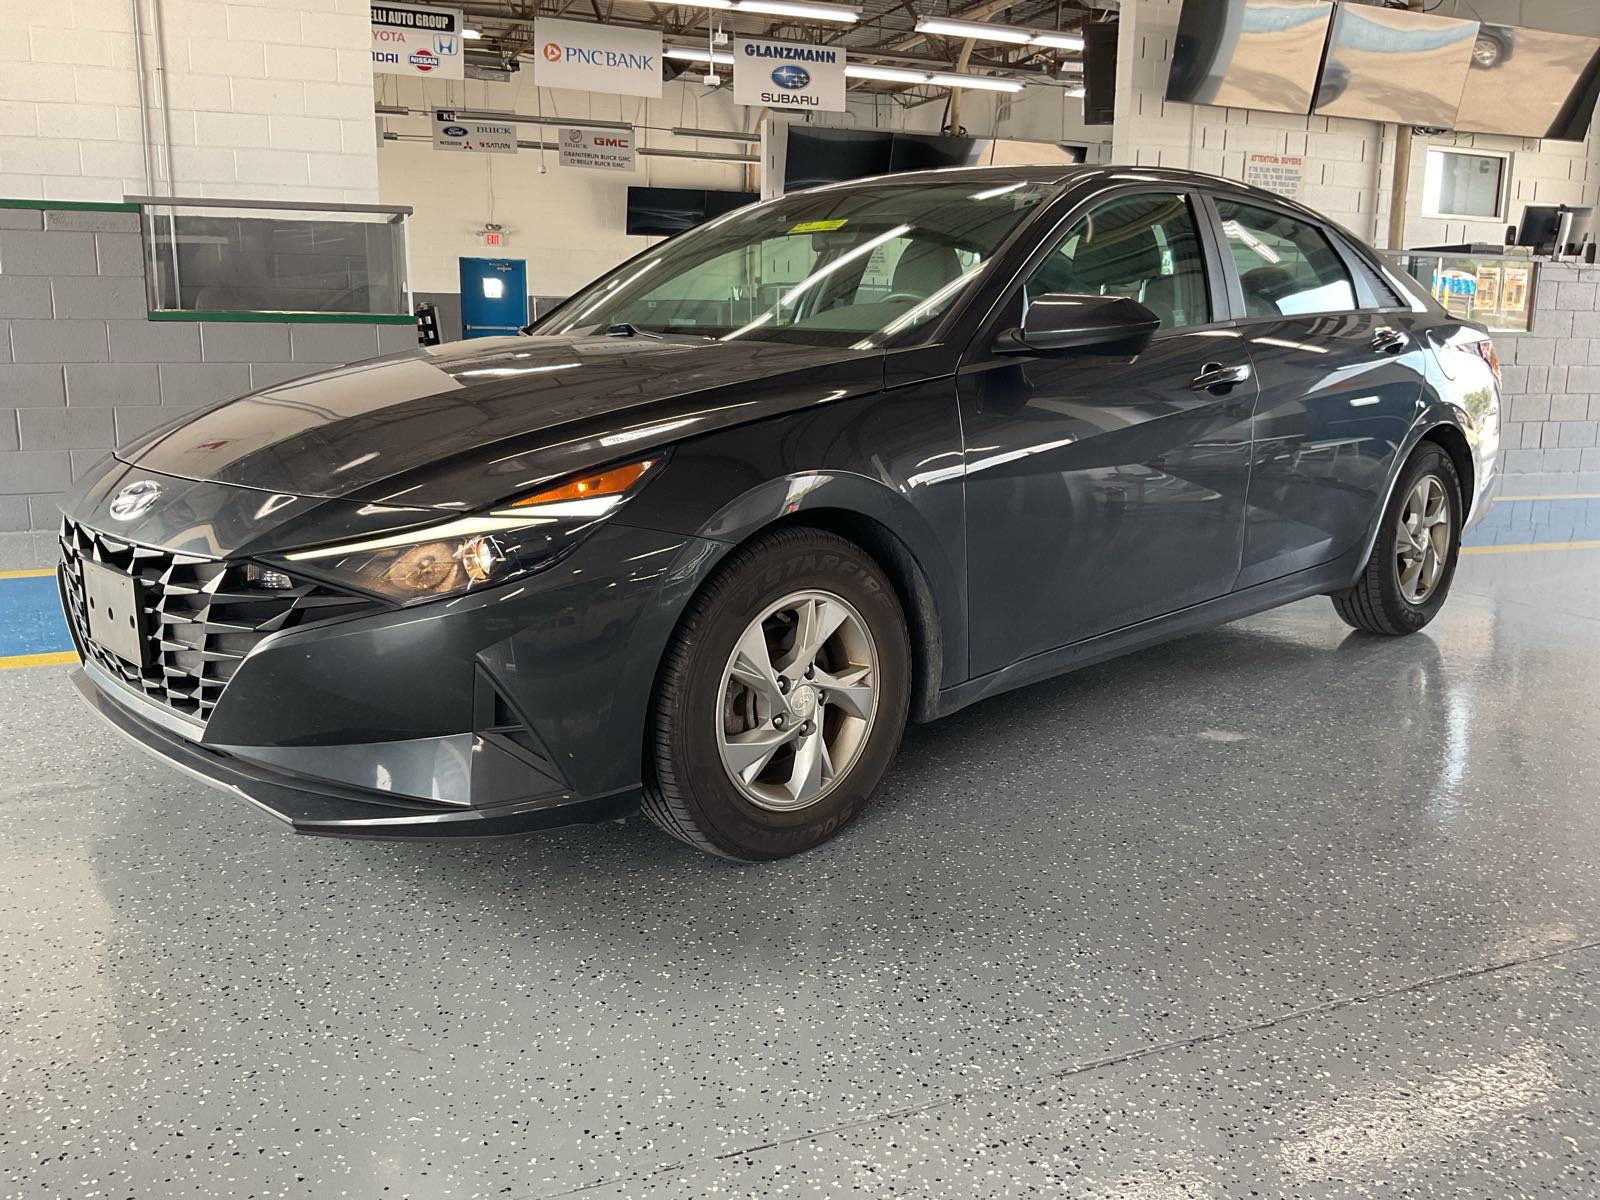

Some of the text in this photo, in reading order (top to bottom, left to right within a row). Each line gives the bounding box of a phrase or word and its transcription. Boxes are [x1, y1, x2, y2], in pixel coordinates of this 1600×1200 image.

[388, 11, 413, 25] AUTO
[415, 13, 449, 29] GROUP
[744, 43, 836, 64] GLANZMANN
[410, 56, 438, 65] NISSAN
[761, 93, 819, 106] SUBARU
[447, 127, 464, 136] Ford
[476, 126, 512, 134] BUICK
[593, 137, 629, 148] GMC
[1281, 156, 1302, 165] BUYERS
[487, 234, 499, 245] EXIT
